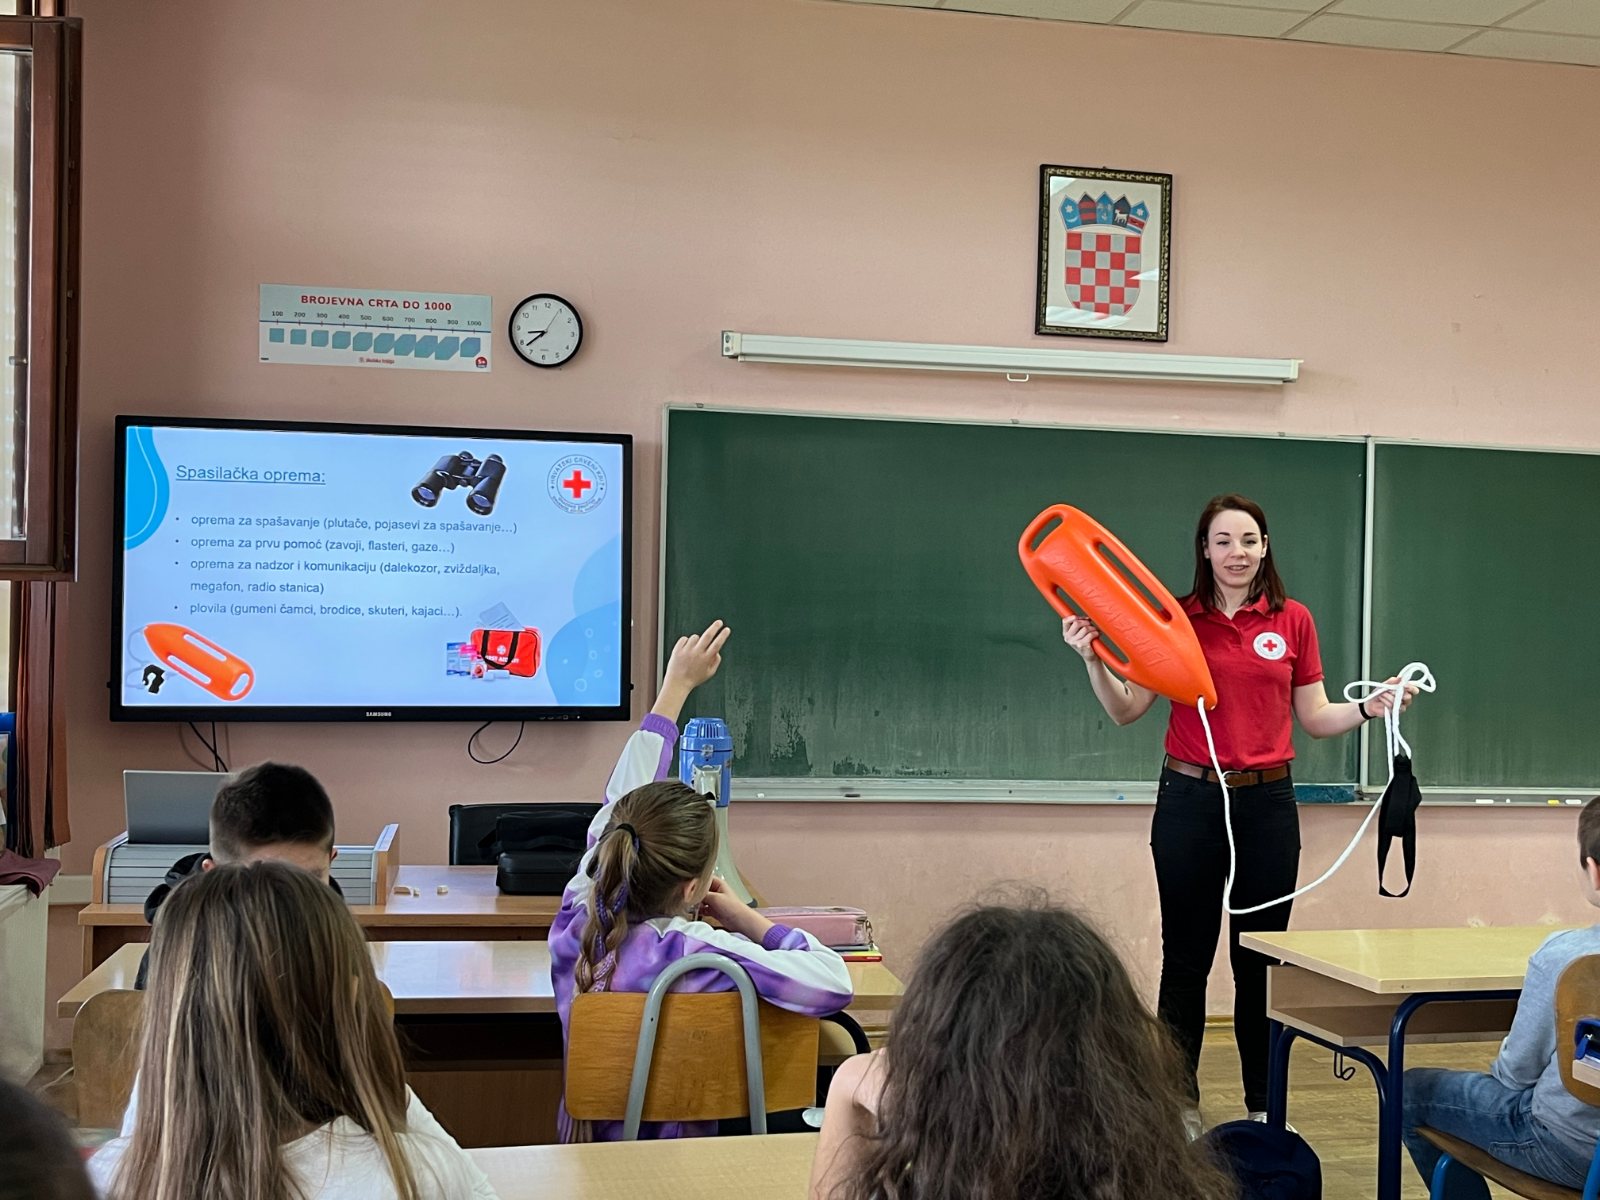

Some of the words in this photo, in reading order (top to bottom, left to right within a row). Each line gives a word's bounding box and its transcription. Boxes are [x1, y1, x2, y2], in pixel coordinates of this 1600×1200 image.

[301, 295, 364, 306] BROJEVNA
[368, 298, 399, 308] CRTA
[402, 300, 420, 309] DO
[424, 302, 452, 311] 1000
[176, 465, 259, 481] Spasilačka
[263, 471, 326, 484] oprema:
[191, 515, 235, 526] oprema
[238, 517, 252, 525] za
[255, 514, 320, 529] spašavanje
[323, 518, 371, 530] (plutače,
[374, 520, 420, 532] pojasevi
[423, 523, 437, 531] za
[191, 538, 235, 549] oprema
[238, 539, 251, 548] za
[255, 539, 283, 550] prvu
[284, 538, 322, 551] pomoć
[325, 540, 365, 552] (zavoji,
[368, 540, 408, 552] flasteri,
[190, 560, 235, 571] oprema
[238, 561, 252, 569] za
[255, 560, 294, 570] nadzor
[304, 561, 377, 574] komunikaciju
[380, 562, 441, 575] (dalekozor,
[443, 563, 500, 577] zviždaljka,
[190, 582, 245, 594] megafon,
[247, 583, 277, 592] radio
[279, 583, 325, 595] stanica)
[190, 604, 227, 615] plovila
[230, 604, 277, 616] (gumeni
[280, 604, 317, 616] čamci,
[320, 605, 365, 617] brodice,
[368, 606, 408, 617] skuteri,
